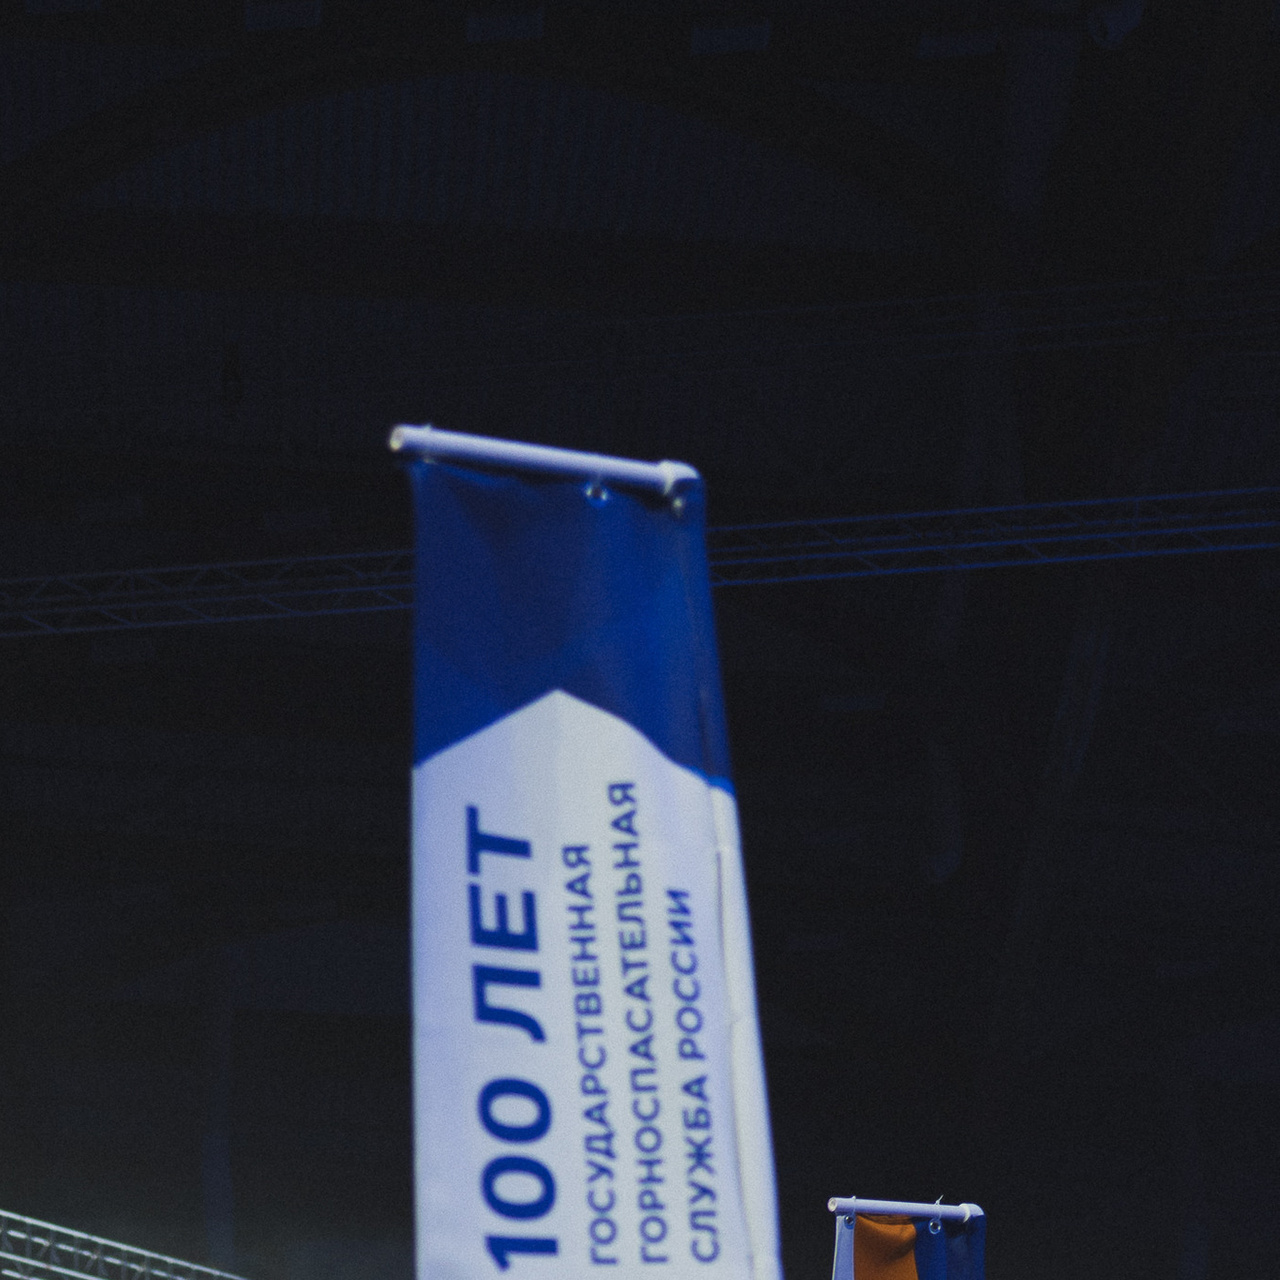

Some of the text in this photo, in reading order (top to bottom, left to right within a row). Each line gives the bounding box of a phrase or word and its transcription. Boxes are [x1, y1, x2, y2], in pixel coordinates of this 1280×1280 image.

[466, 806, 558, 1271] 100 ЛЕТ
[562, 845, 617, 1265] ГОСУДАРСТВЕННАЯ
[608, 782, 668, 1264] ГОРНОСПАСАТЕЛЬНАЯ
[666, 889, 720, 1263] СЛУЖБА РОССИИ
